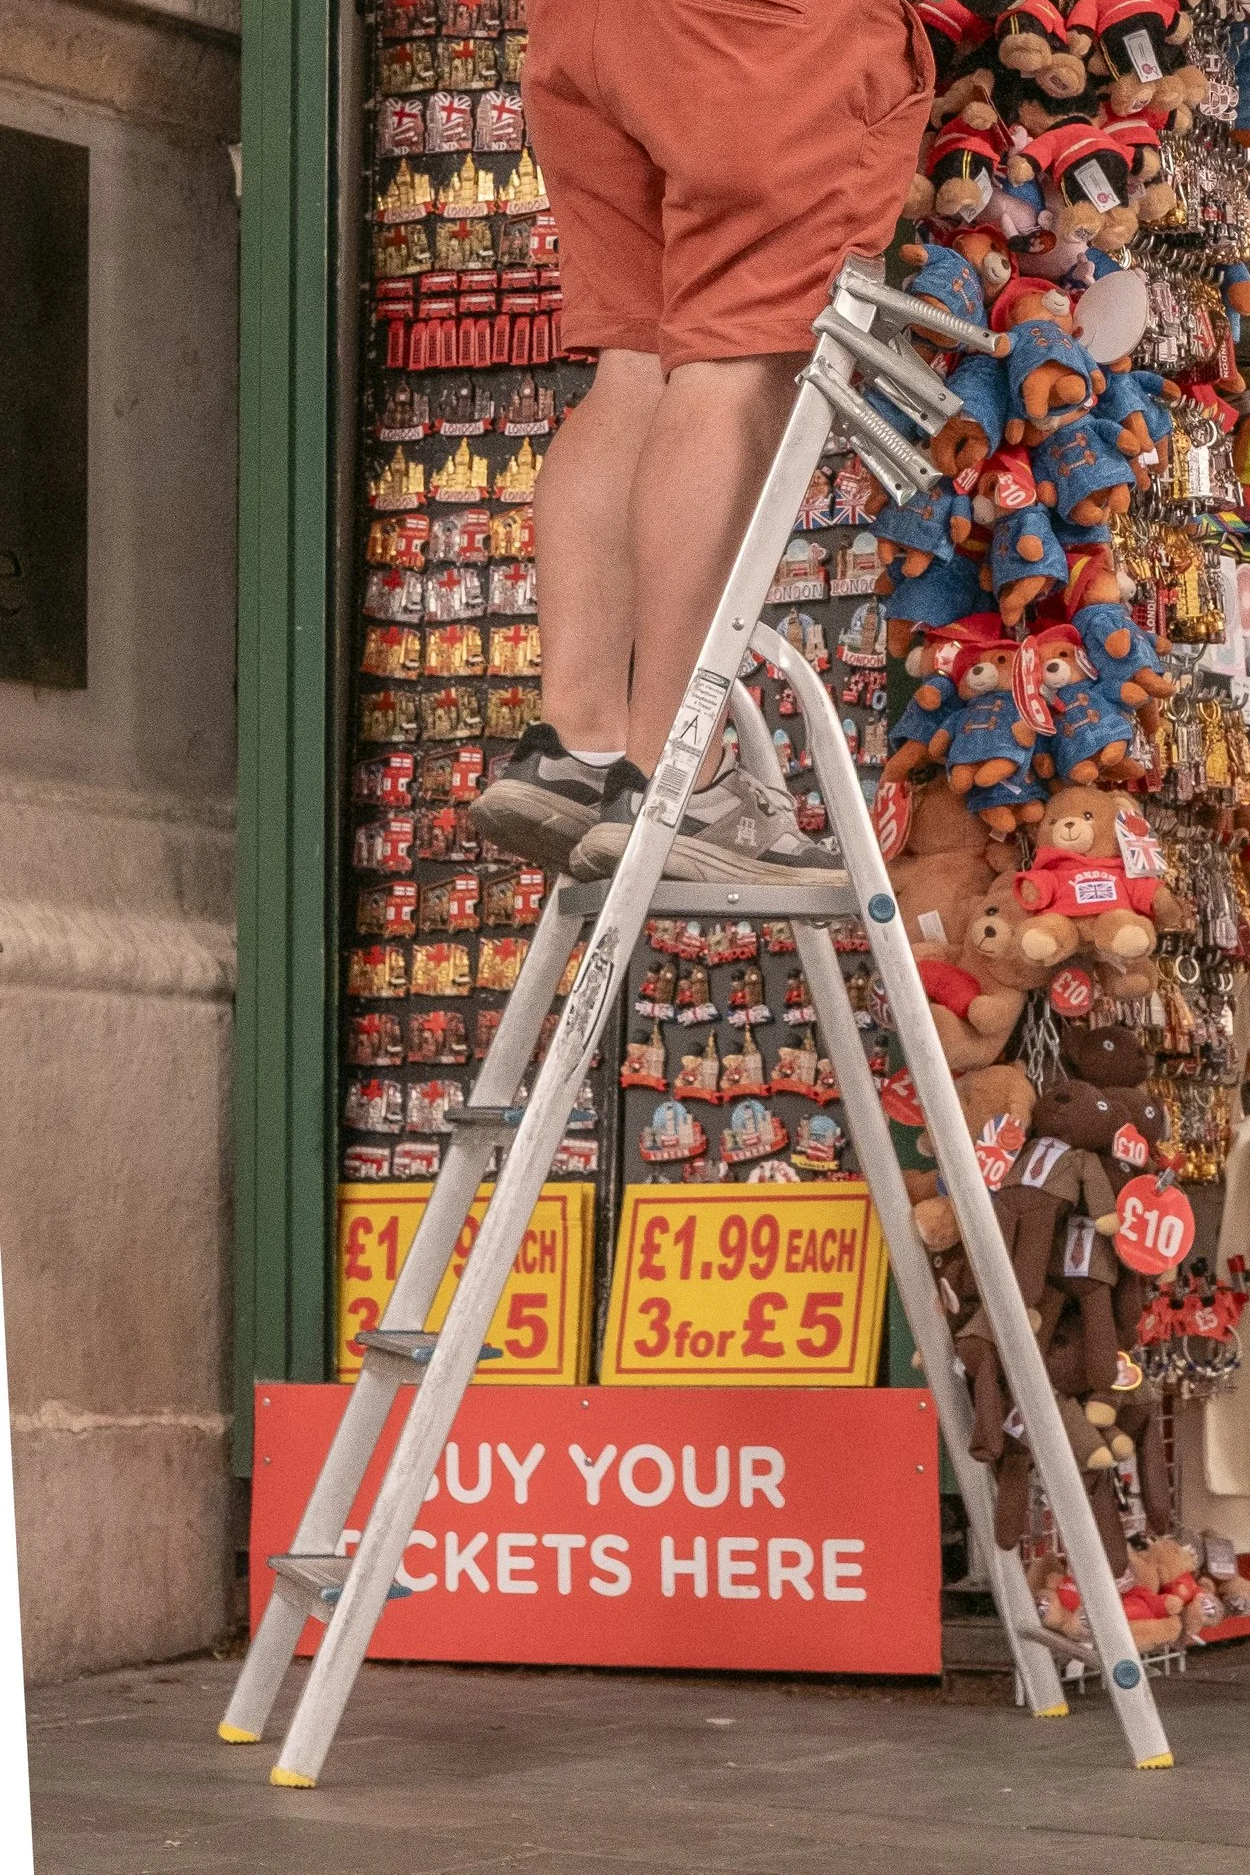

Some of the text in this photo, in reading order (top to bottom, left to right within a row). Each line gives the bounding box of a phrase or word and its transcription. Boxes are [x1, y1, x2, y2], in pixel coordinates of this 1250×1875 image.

[1220, 340, 1229, 379] ONDON
[1069, 869, 1117, 885] LONDON
[1051, 975, 1089, 1006] £10
[1118, 1137, 1147, 1162] £10
[344, 1215, 557, 1282] £19 CH
[637, 1213, 855, 1282] £1.99 EACH
[1119, 1197, 1185, 1258] £10
[568, 1443, 787, 1510] YOUR
[335, 1528, 868, 1603] CKETS HERE
